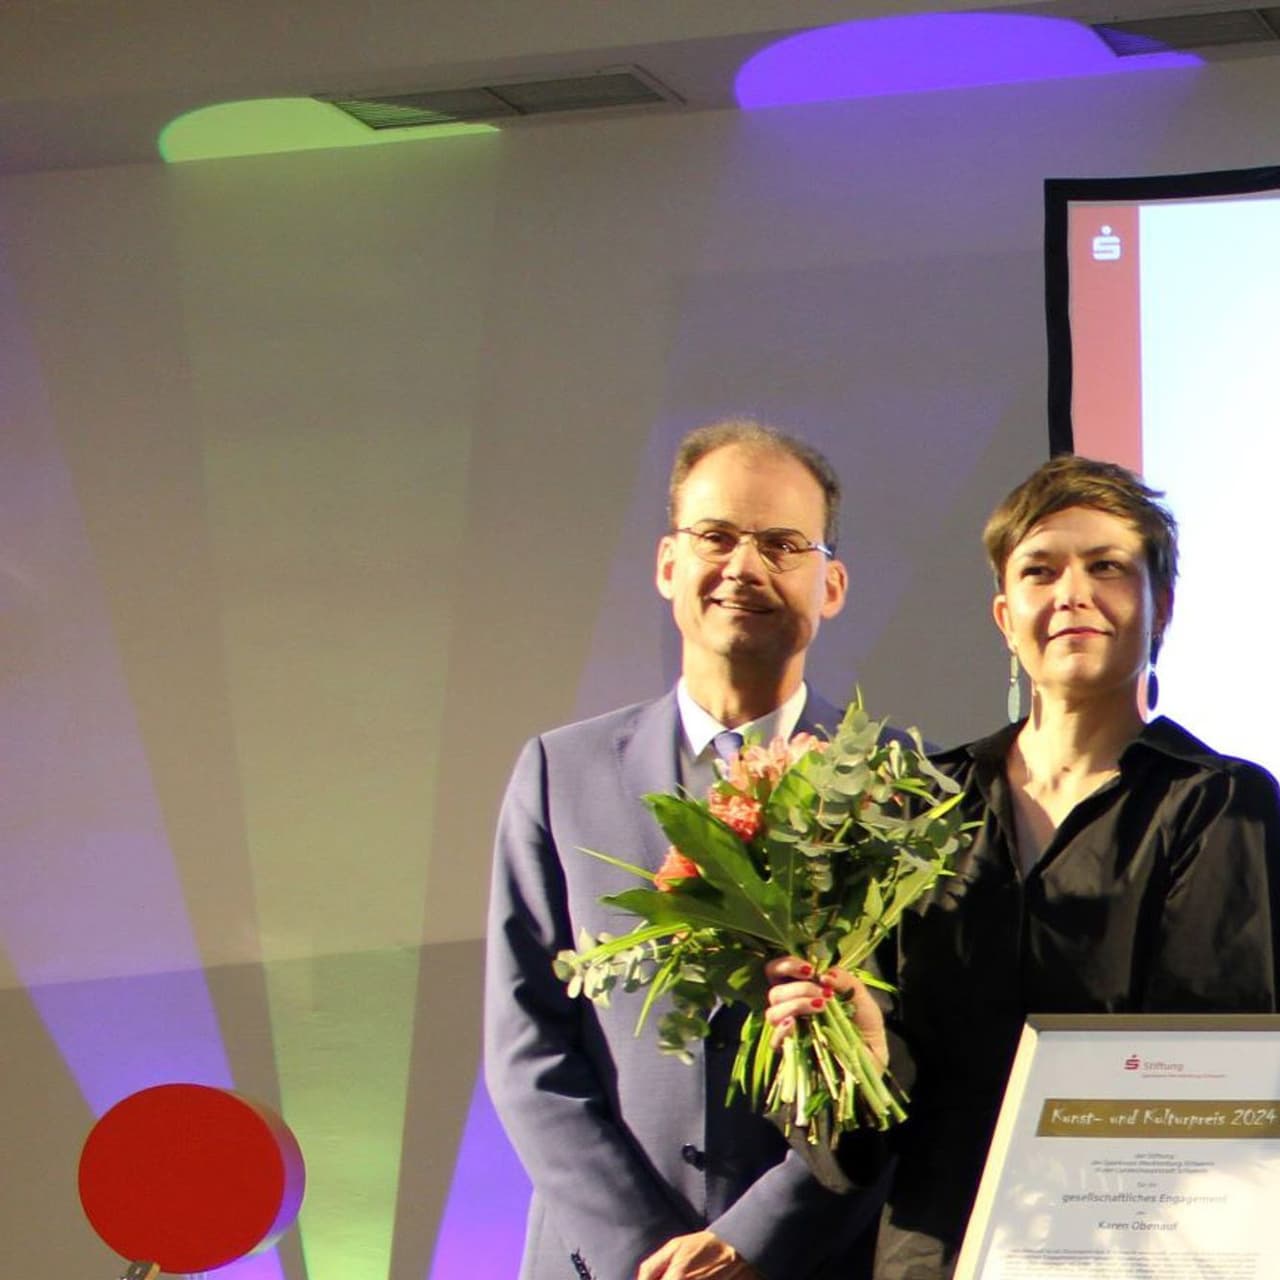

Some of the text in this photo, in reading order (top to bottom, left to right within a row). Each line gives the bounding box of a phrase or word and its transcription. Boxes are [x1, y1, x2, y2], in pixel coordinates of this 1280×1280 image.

[1051, 1108, 1278, 1129] Kunst- und Kulturpreis 2024
